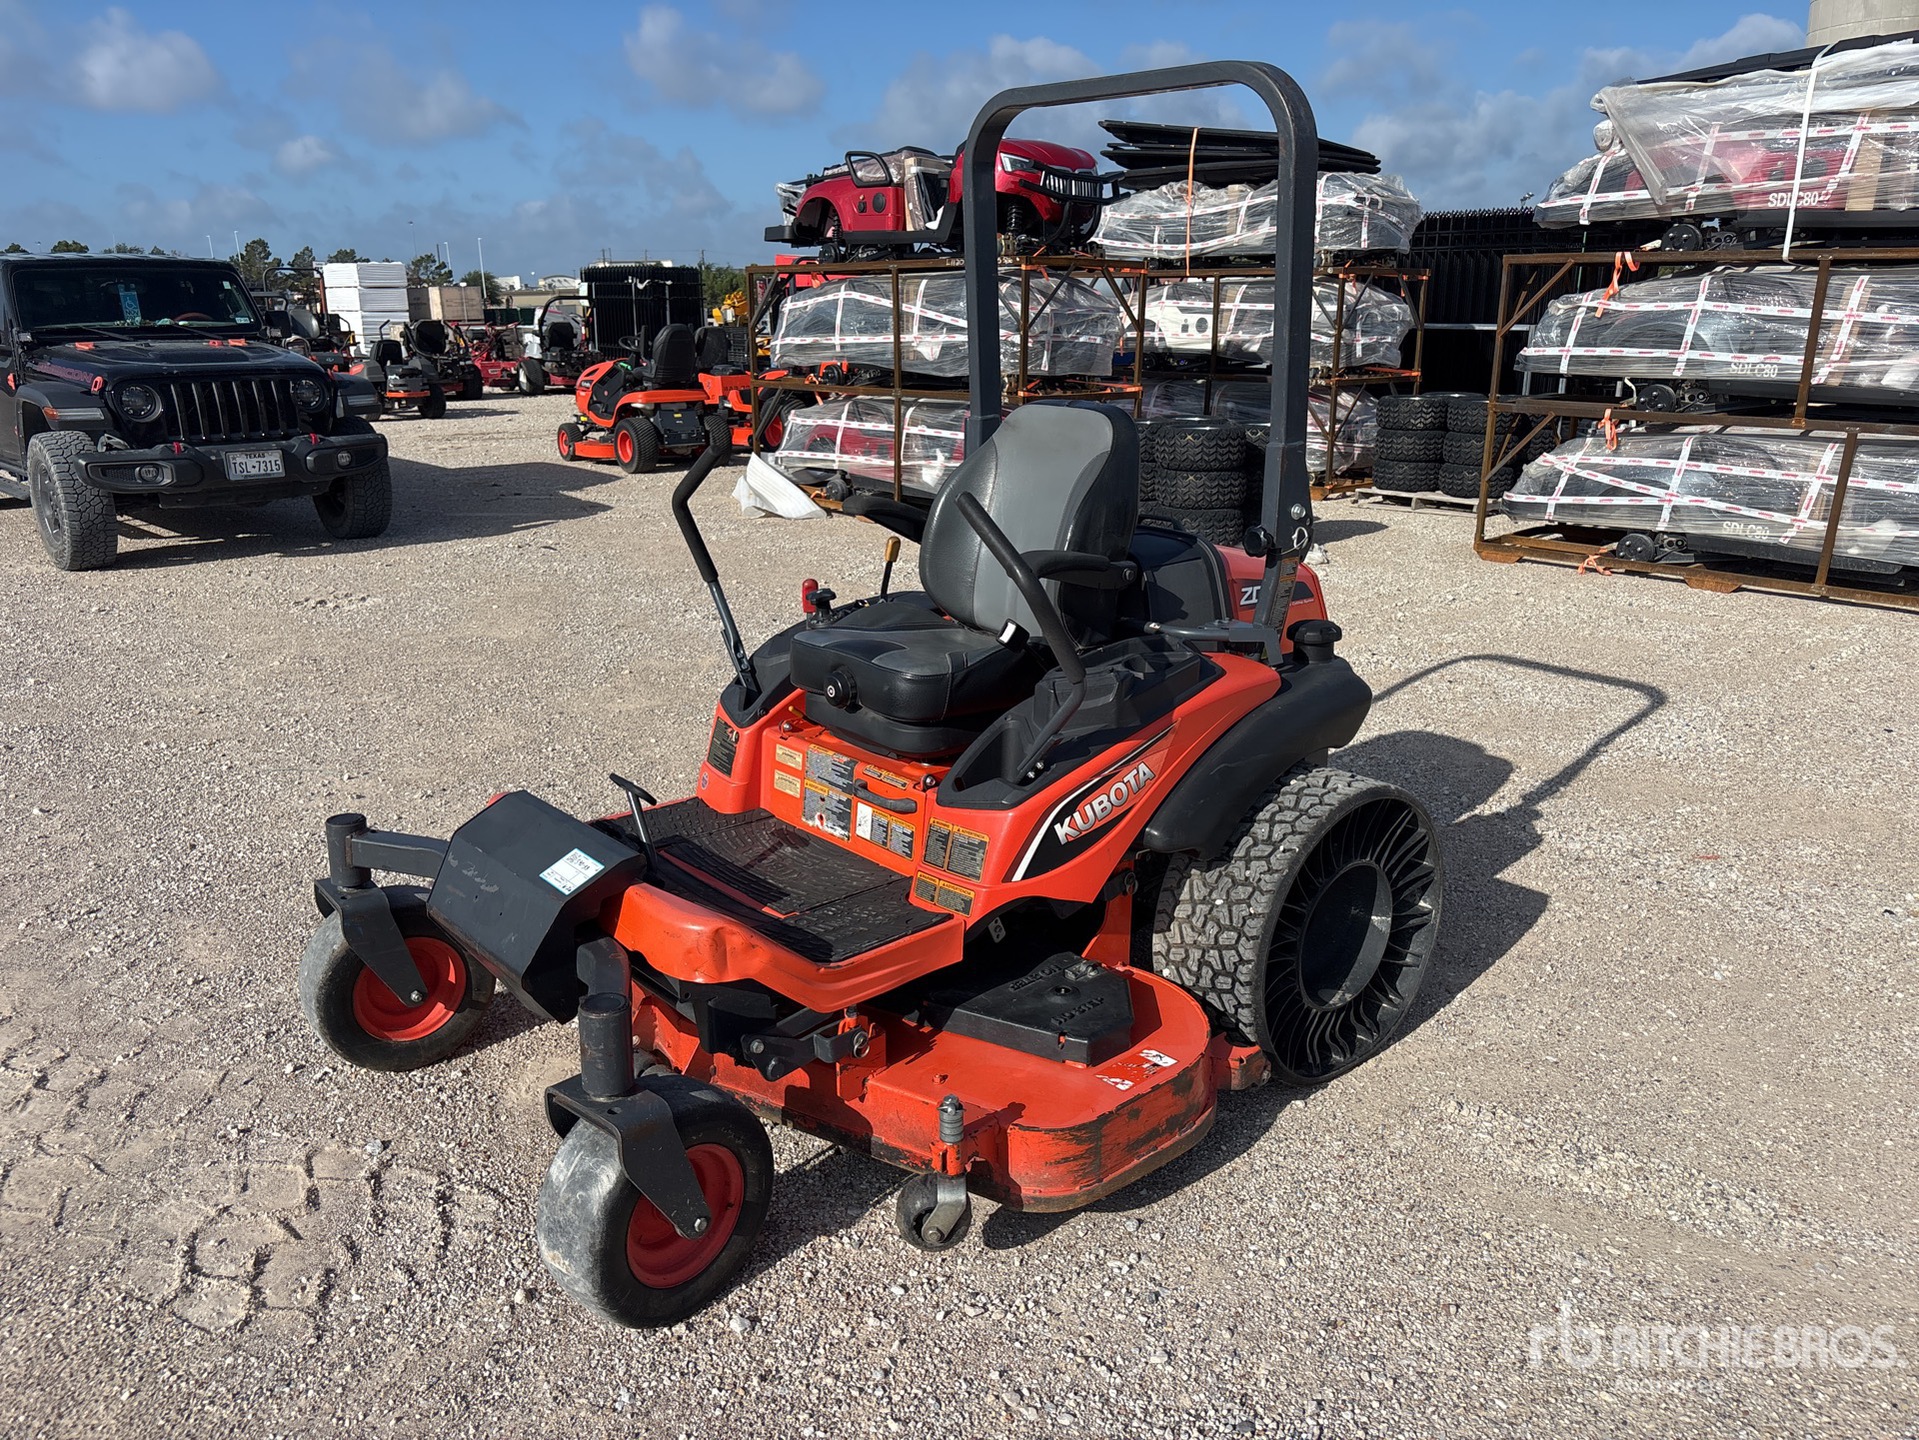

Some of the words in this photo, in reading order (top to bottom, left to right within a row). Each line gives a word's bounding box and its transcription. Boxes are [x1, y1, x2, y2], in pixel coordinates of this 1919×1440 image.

[1767, 191, 1819, 208] SDLC80
[1729, 362, 1779, 378] SDLC80
[244, 452, 266, 460] TEXAS
[1722, 520, 1770, 540] SDLC80
[1053, 761, 1156, 845] KUBOTA
